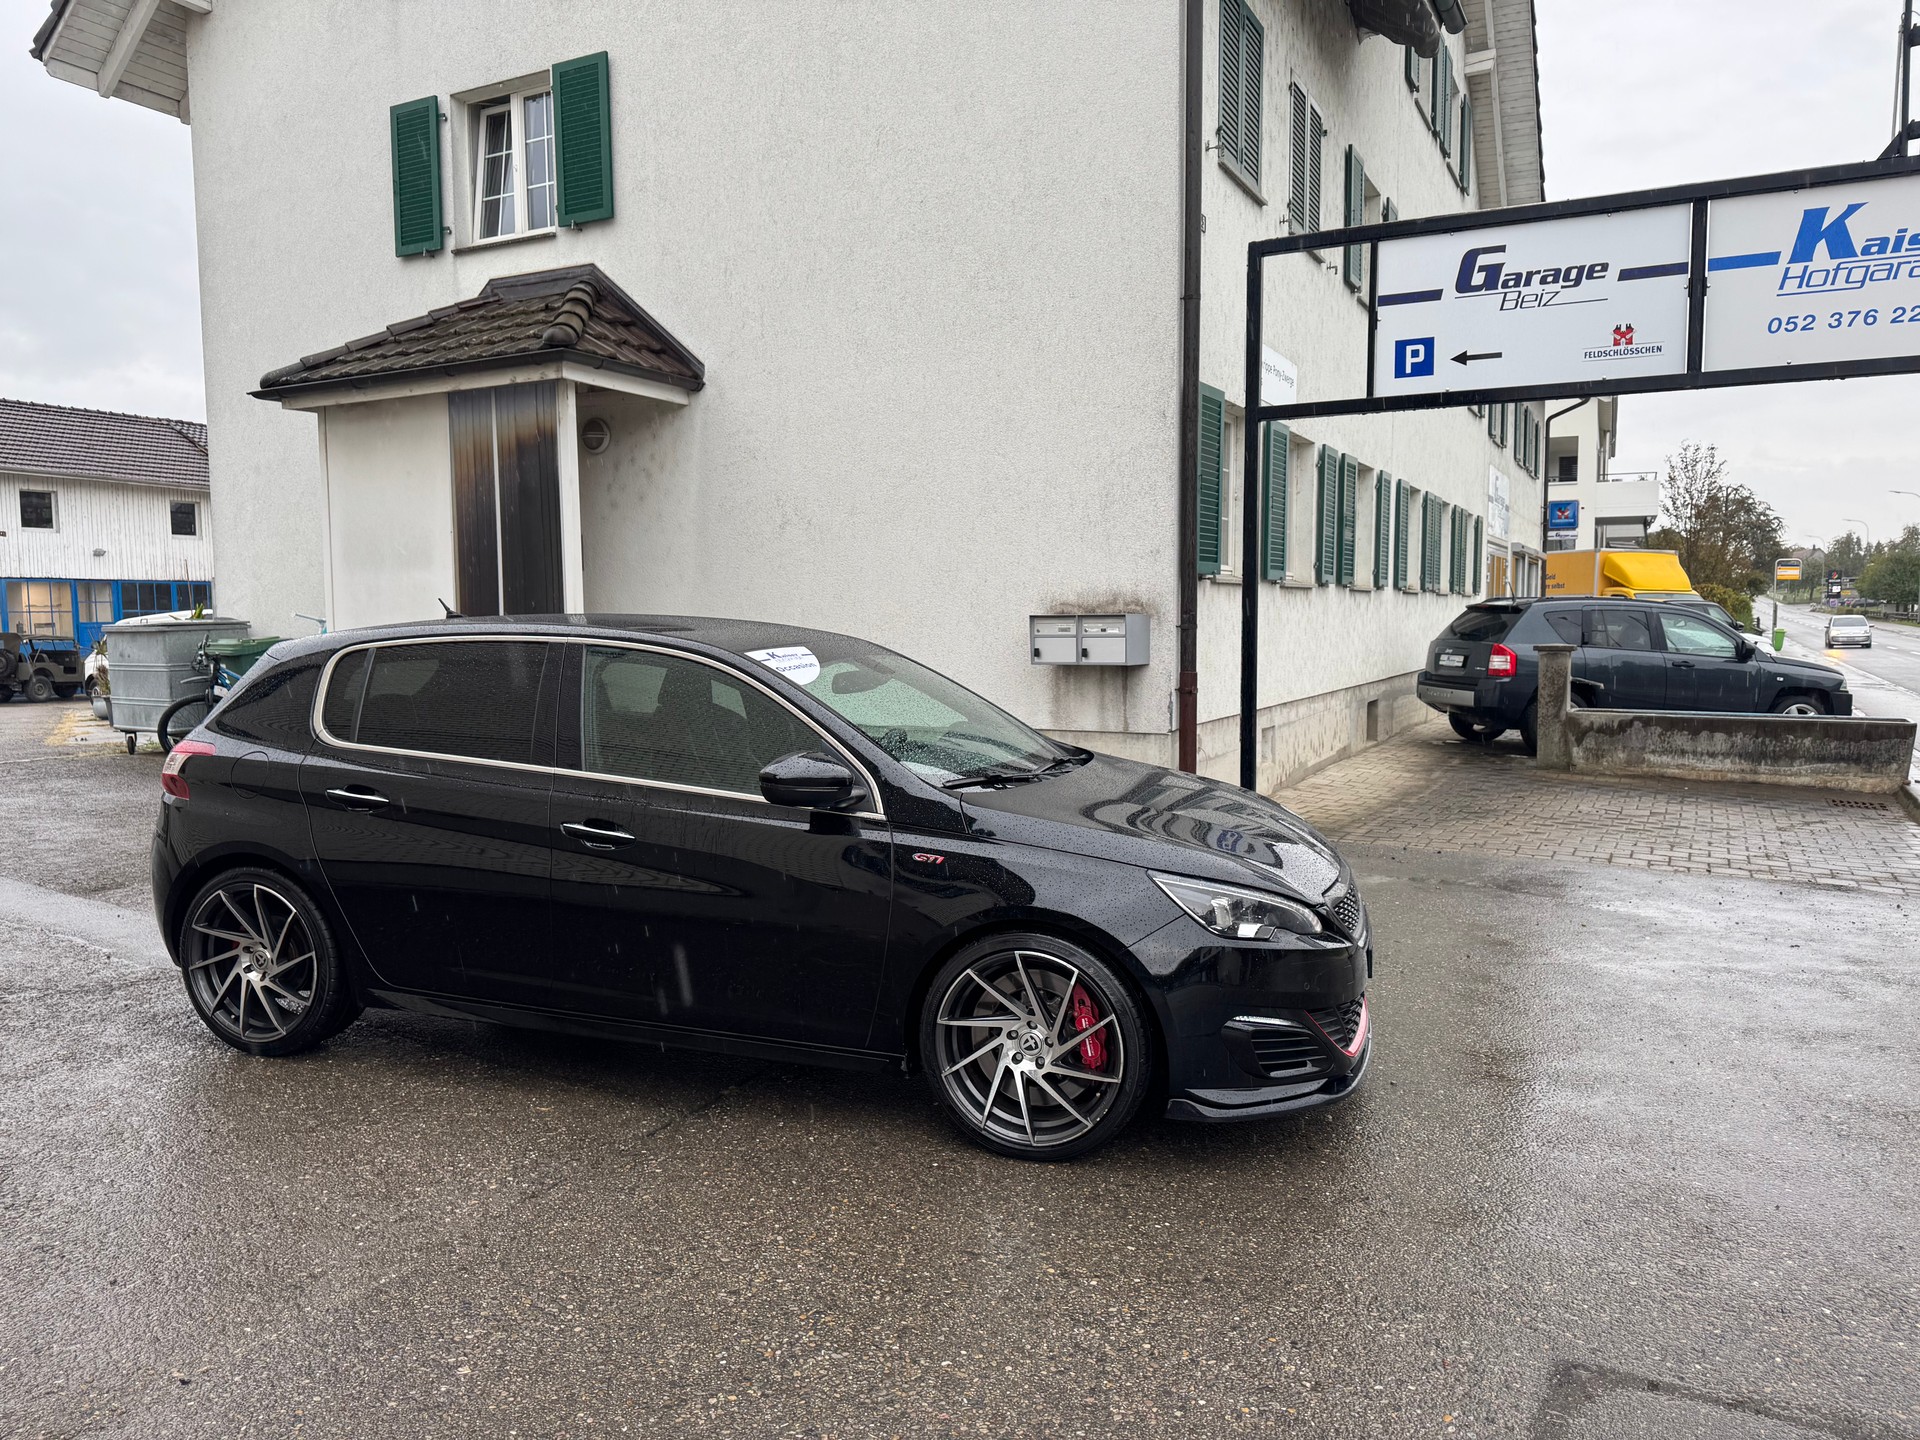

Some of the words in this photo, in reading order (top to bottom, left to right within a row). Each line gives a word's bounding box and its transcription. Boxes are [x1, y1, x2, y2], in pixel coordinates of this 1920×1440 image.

[1455, 244, 1609, 294] Garage
[1499, 289, 1561, 311] Beiz
[1767, 314, 1817, 335] 052
[1827, 308, 1879, 330] 376
[1405, 344, 1425, 374] P
[1584, 345, 1663, 359] FELDSCHLÖSSCHEN
